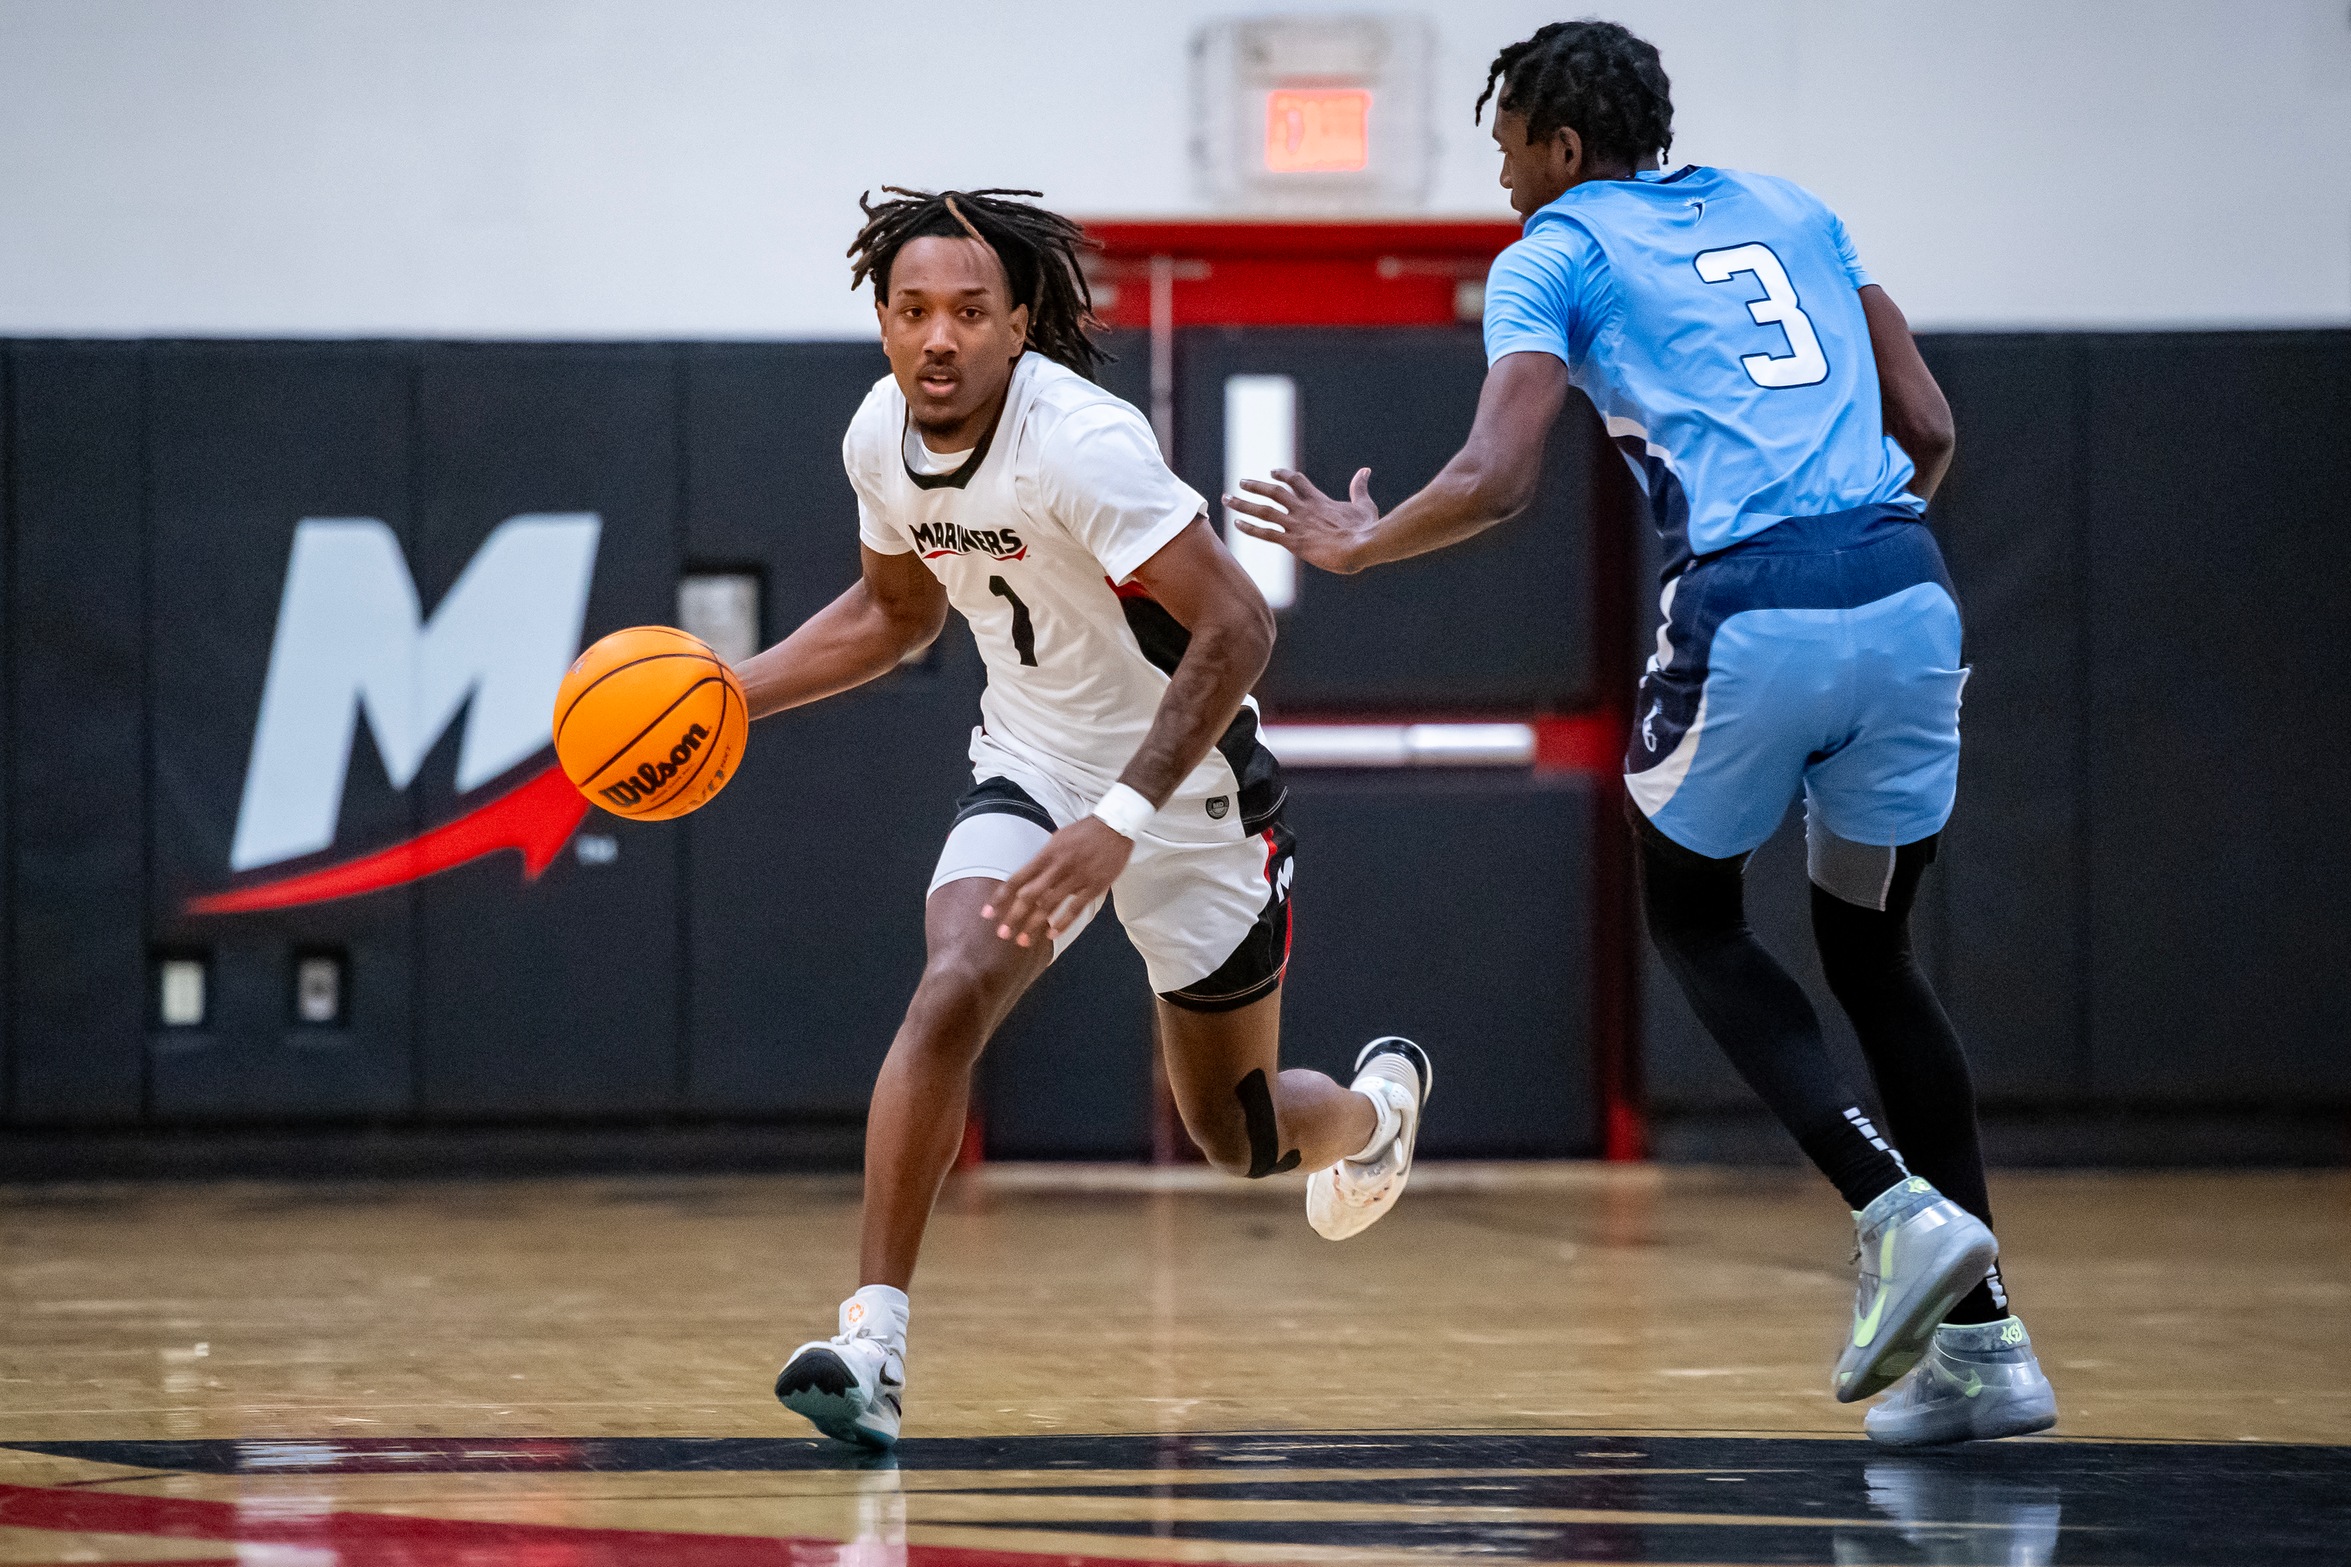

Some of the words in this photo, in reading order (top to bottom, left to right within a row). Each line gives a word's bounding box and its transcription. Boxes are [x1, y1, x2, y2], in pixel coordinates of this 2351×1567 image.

[1693, 240, 1830, 390] 3
[908, 522, 1023, 555] MARINERS
[988, 575, 1038, 667] 1
[229, 511, 602, 873] M
[598, 722, 710, 808] Wilson
